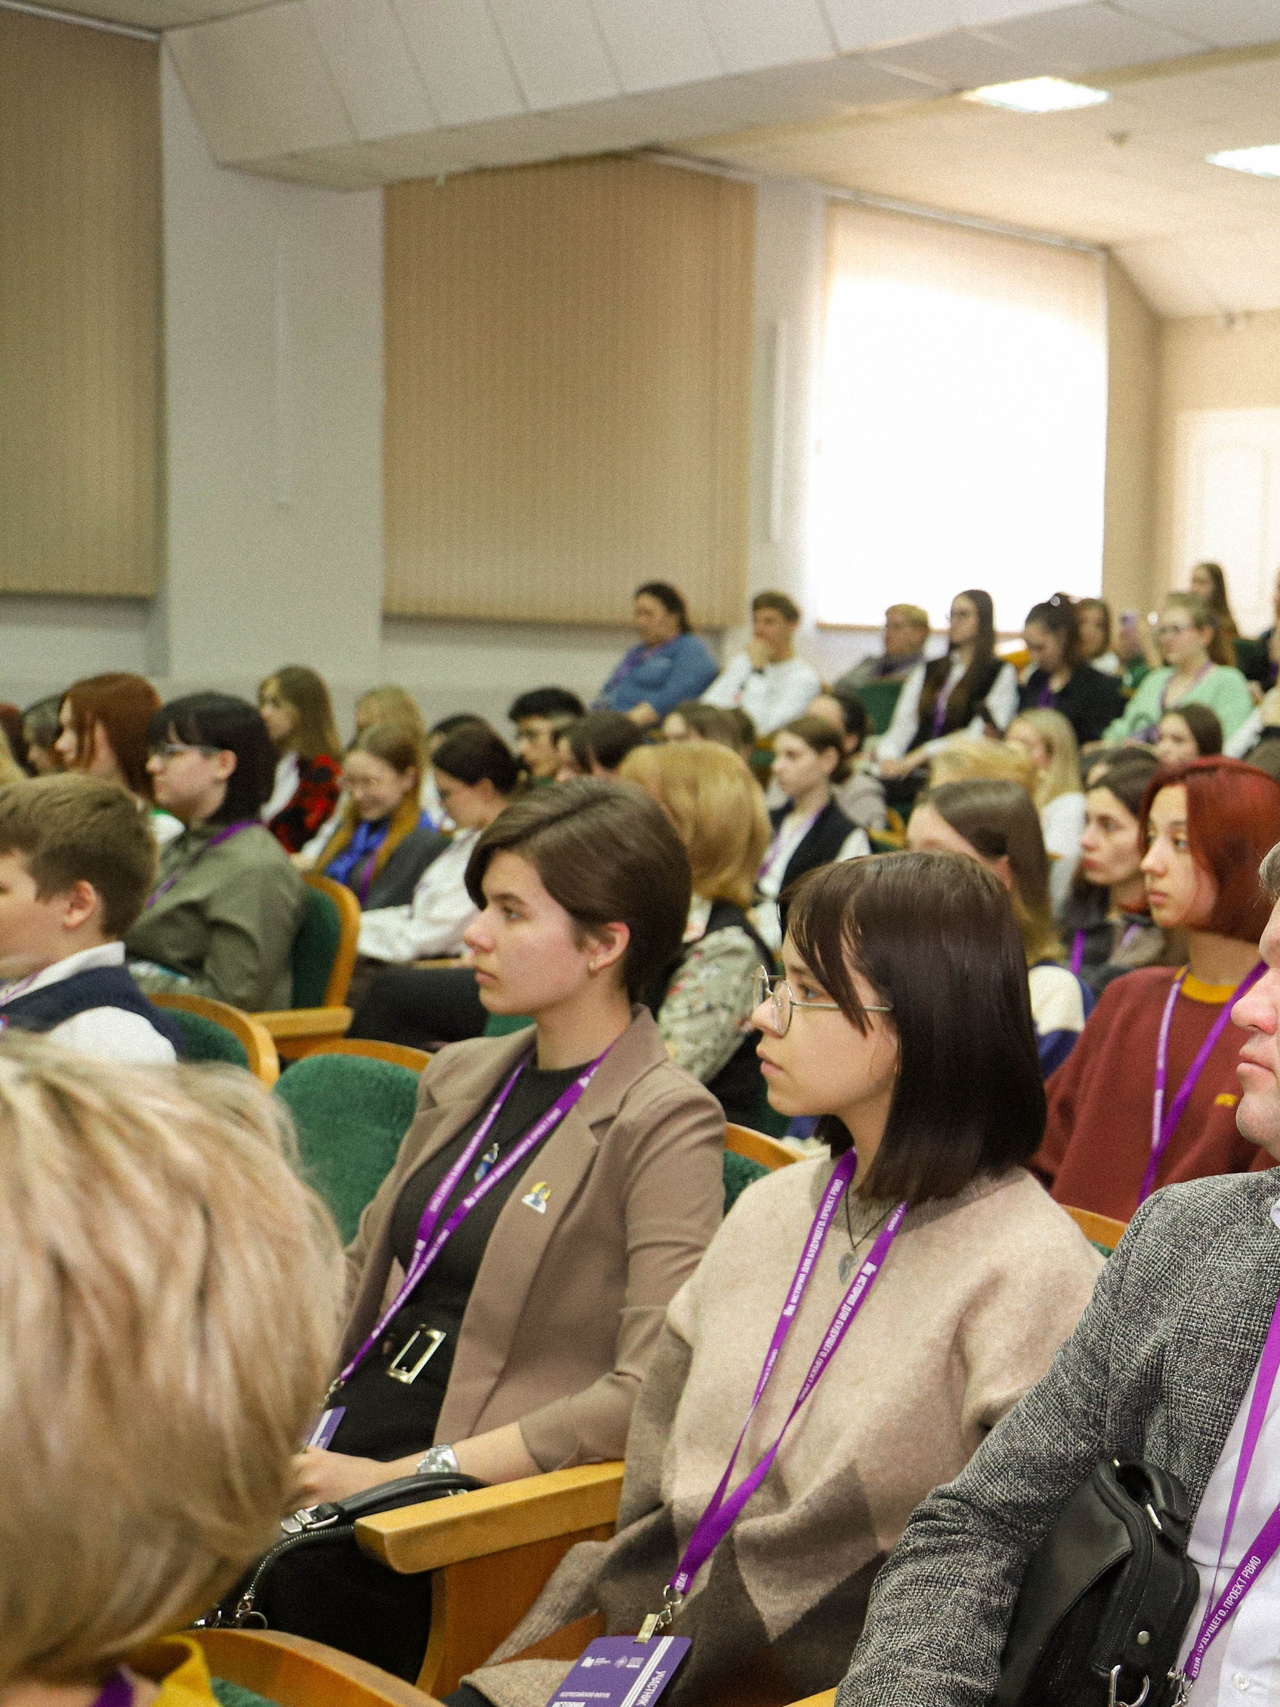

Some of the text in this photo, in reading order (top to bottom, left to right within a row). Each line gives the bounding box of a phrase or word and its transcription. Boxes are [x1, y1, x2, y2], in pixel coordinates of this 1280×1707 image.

[791, 1273, 806, 1303] ИСТОРИЯ
[801, 1258, 813, 1274] ДЛЯ
[821, 1195, 836, 1220] ПРОЕКТ
[846, 1274, 868, 1306] ИСТОРИЯ
[839, 1303, 852, 1321] ДЛЯ
[1191, 1657, 1200, 1678] ДЛЯ
[1223, 1576, 1245, 1609] ПРОЕКТ
[1241, 1555, 1261, 1579] РВИО
[635, 1670, 667, 1707] УЧАСТНИК
